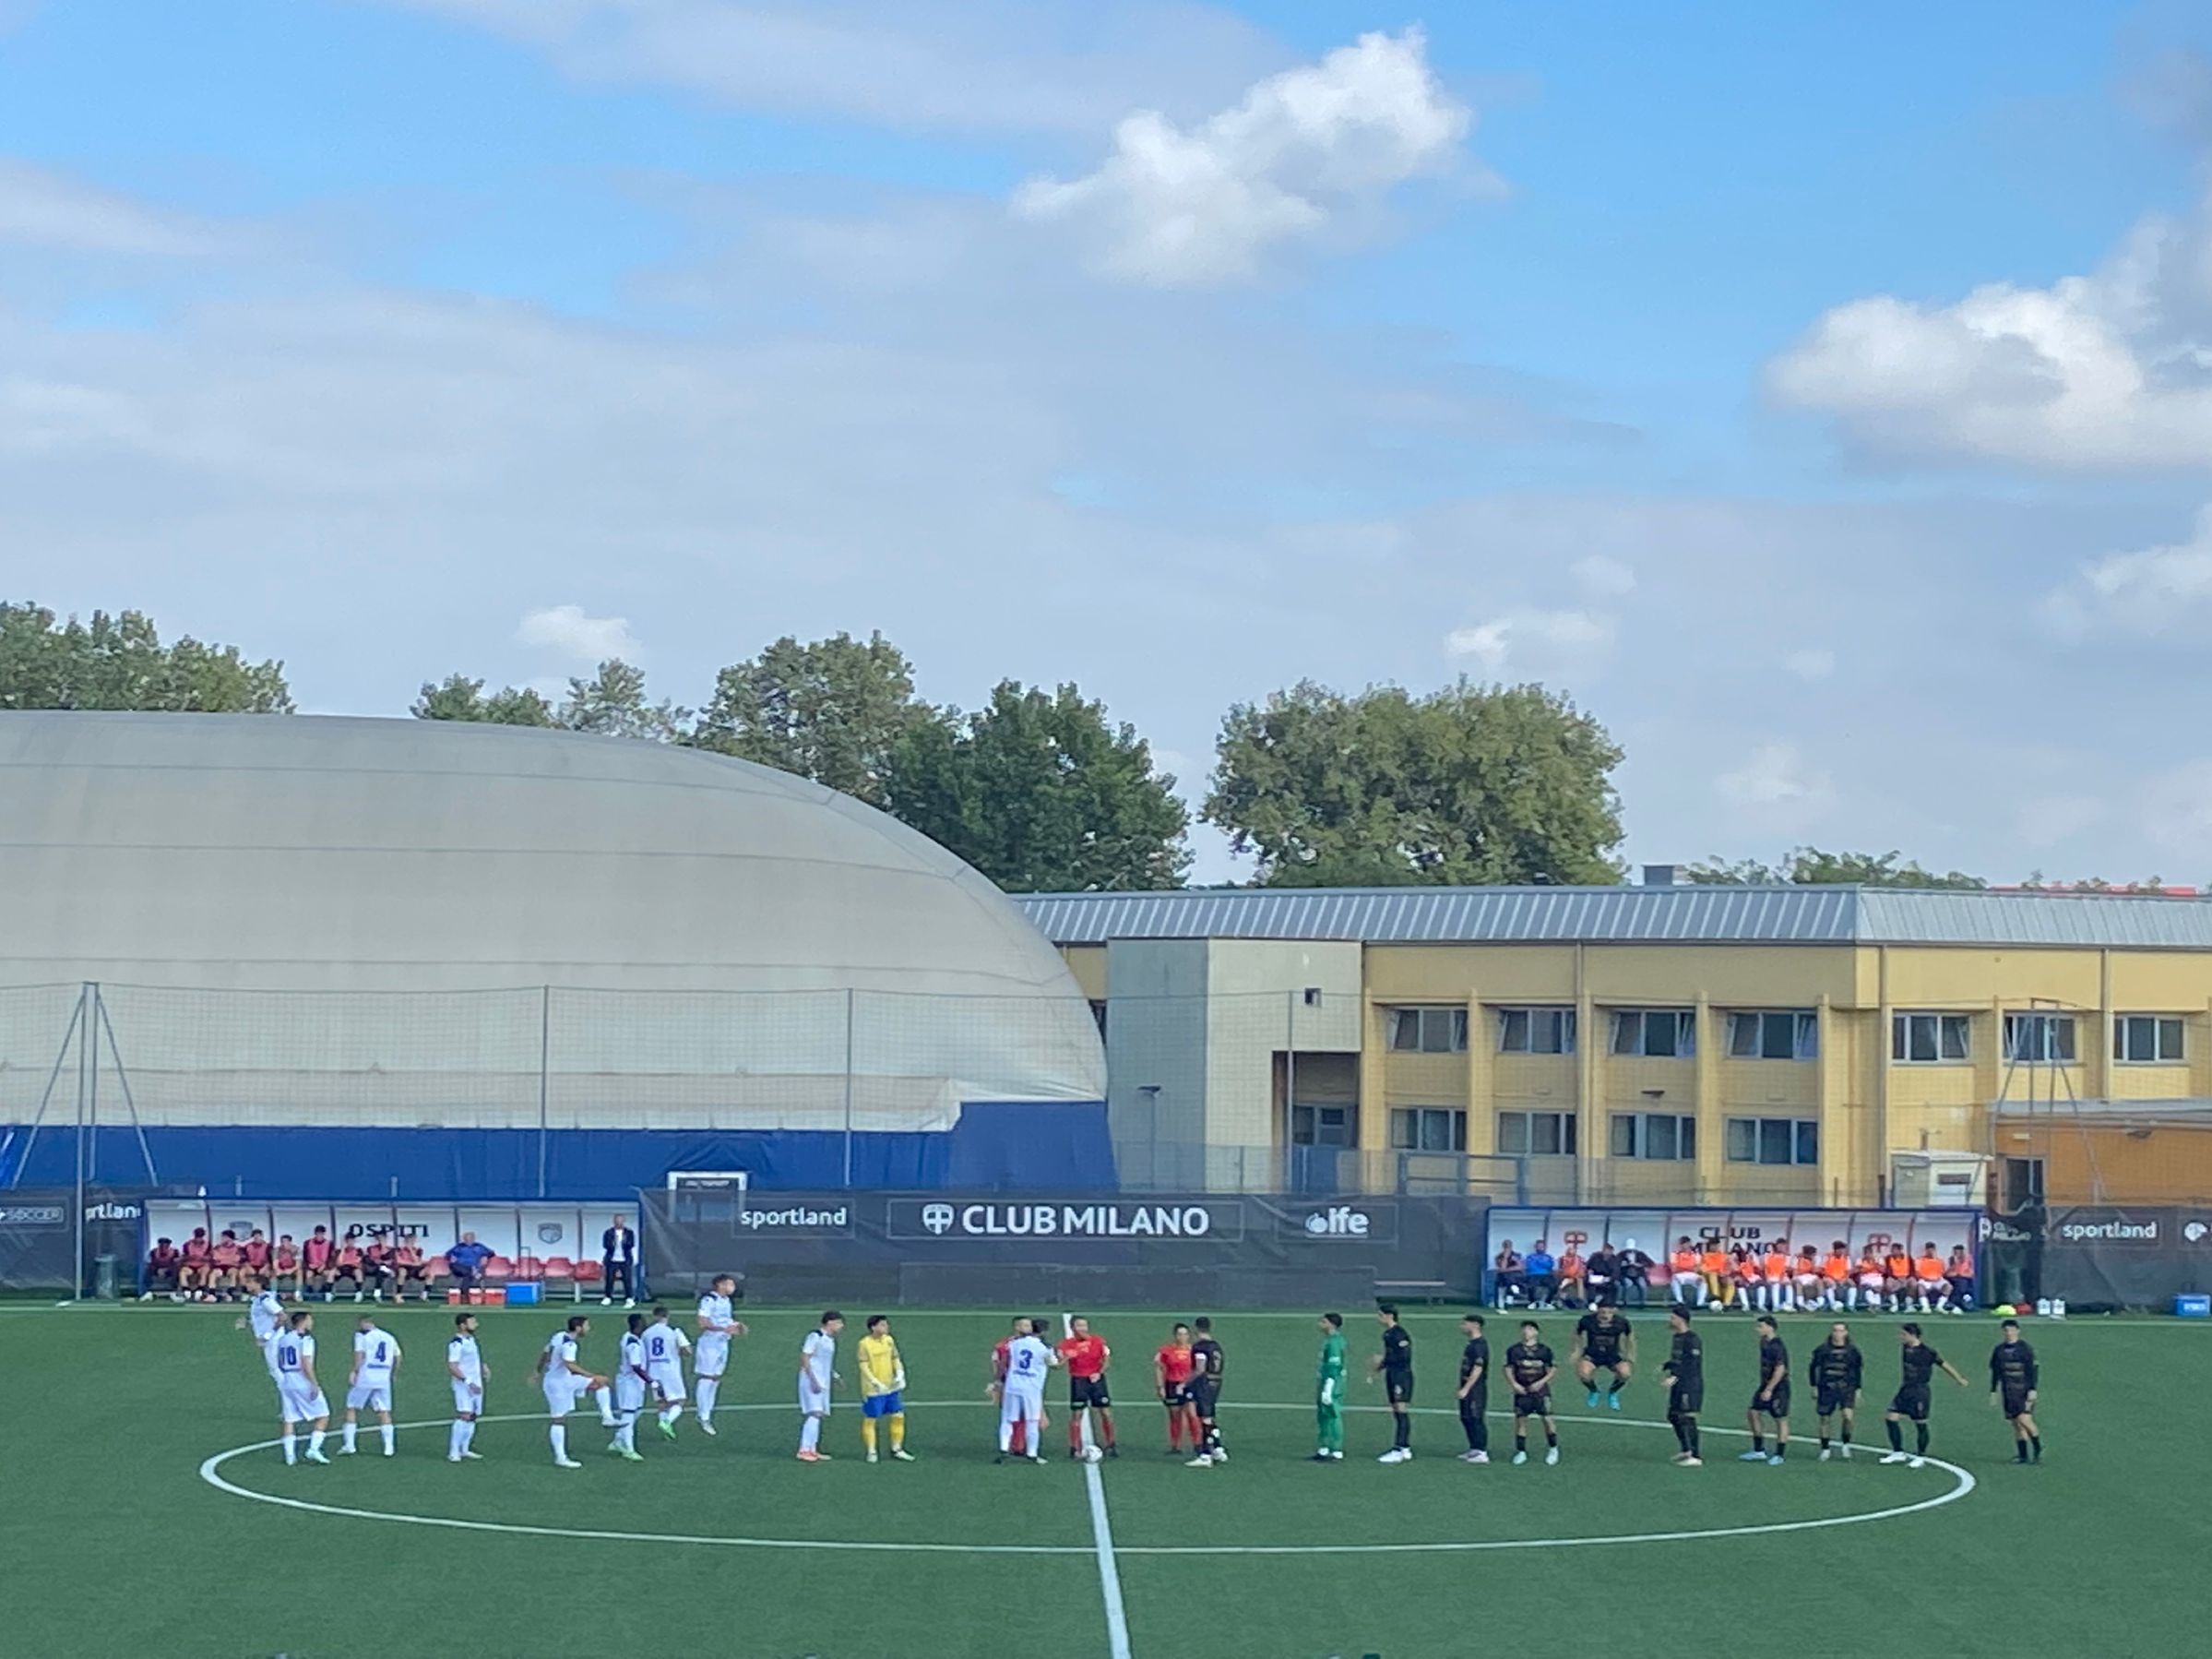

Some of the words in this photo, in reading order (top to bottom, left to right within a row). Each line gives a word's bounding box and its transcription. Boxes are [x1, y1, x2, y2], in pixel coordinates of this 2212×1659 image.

[741, 1206, 848, 1230] sportland
[961, 1204, 1056, 1235] CLUB
[1063, 1205, 1210, 1235] MILANO
[1699, 1226, 1761, 1239] CLUB
[2062, 1221, 2158, 1242] sportland
[374, 1341, 387, 1363] 4
[651, 1336, 665, 1356] 8
[1019, 1349, 1033, 1369] 3
